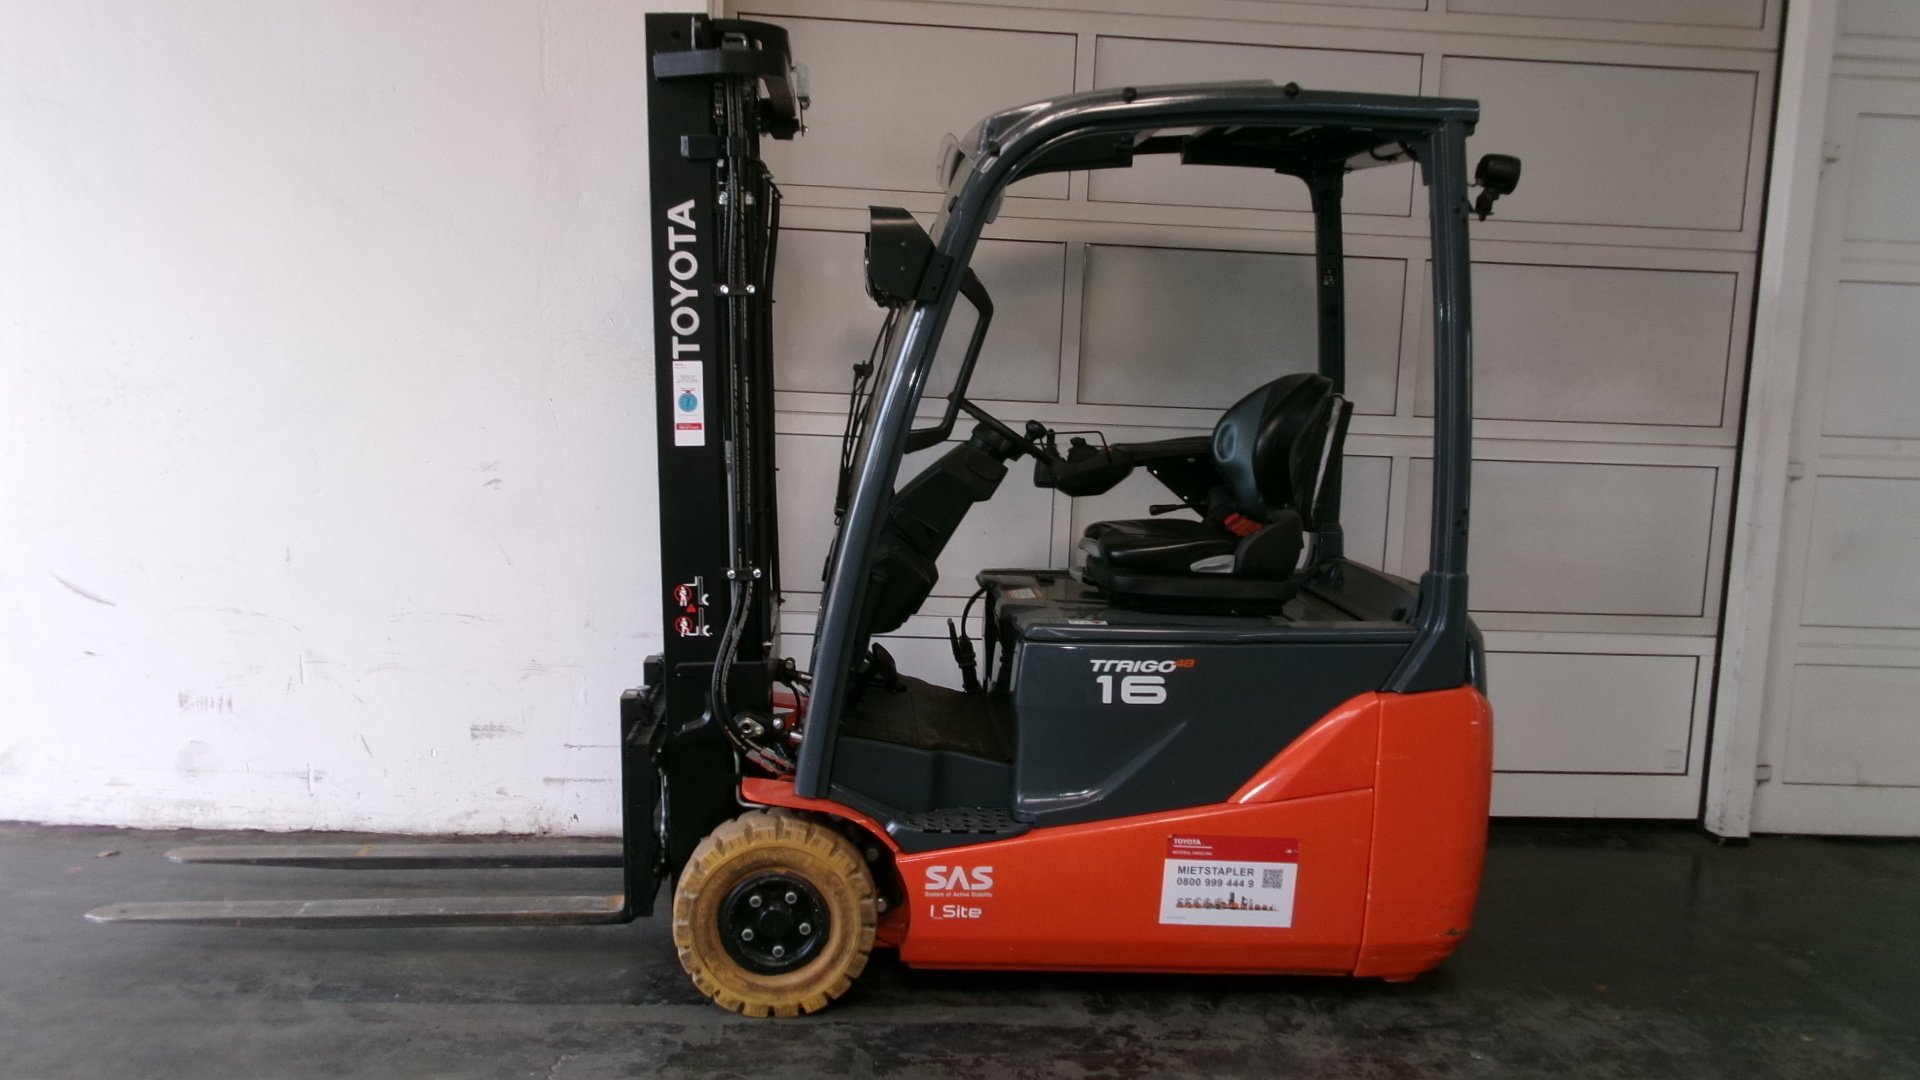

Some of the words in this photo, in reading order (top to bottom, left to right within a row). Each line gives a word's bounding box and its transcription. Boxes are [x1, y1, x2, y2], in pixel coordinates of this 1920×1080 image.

[667, 199, 700, 360] TOYOTA
[1096, 675, 1167, 705] 16
[1173, 838, 1201, 846] TOYOTA
[925, 865, 993, 890] SAS
[1177, 865, 1255, 877] MIETSTAPLER
[1176, 876, 1201, 887] 0800
[1204, 878, 1223, 887] 999
[1226, 879, 1245, 888] 444
[1247, 880, 1254, 888] 9
